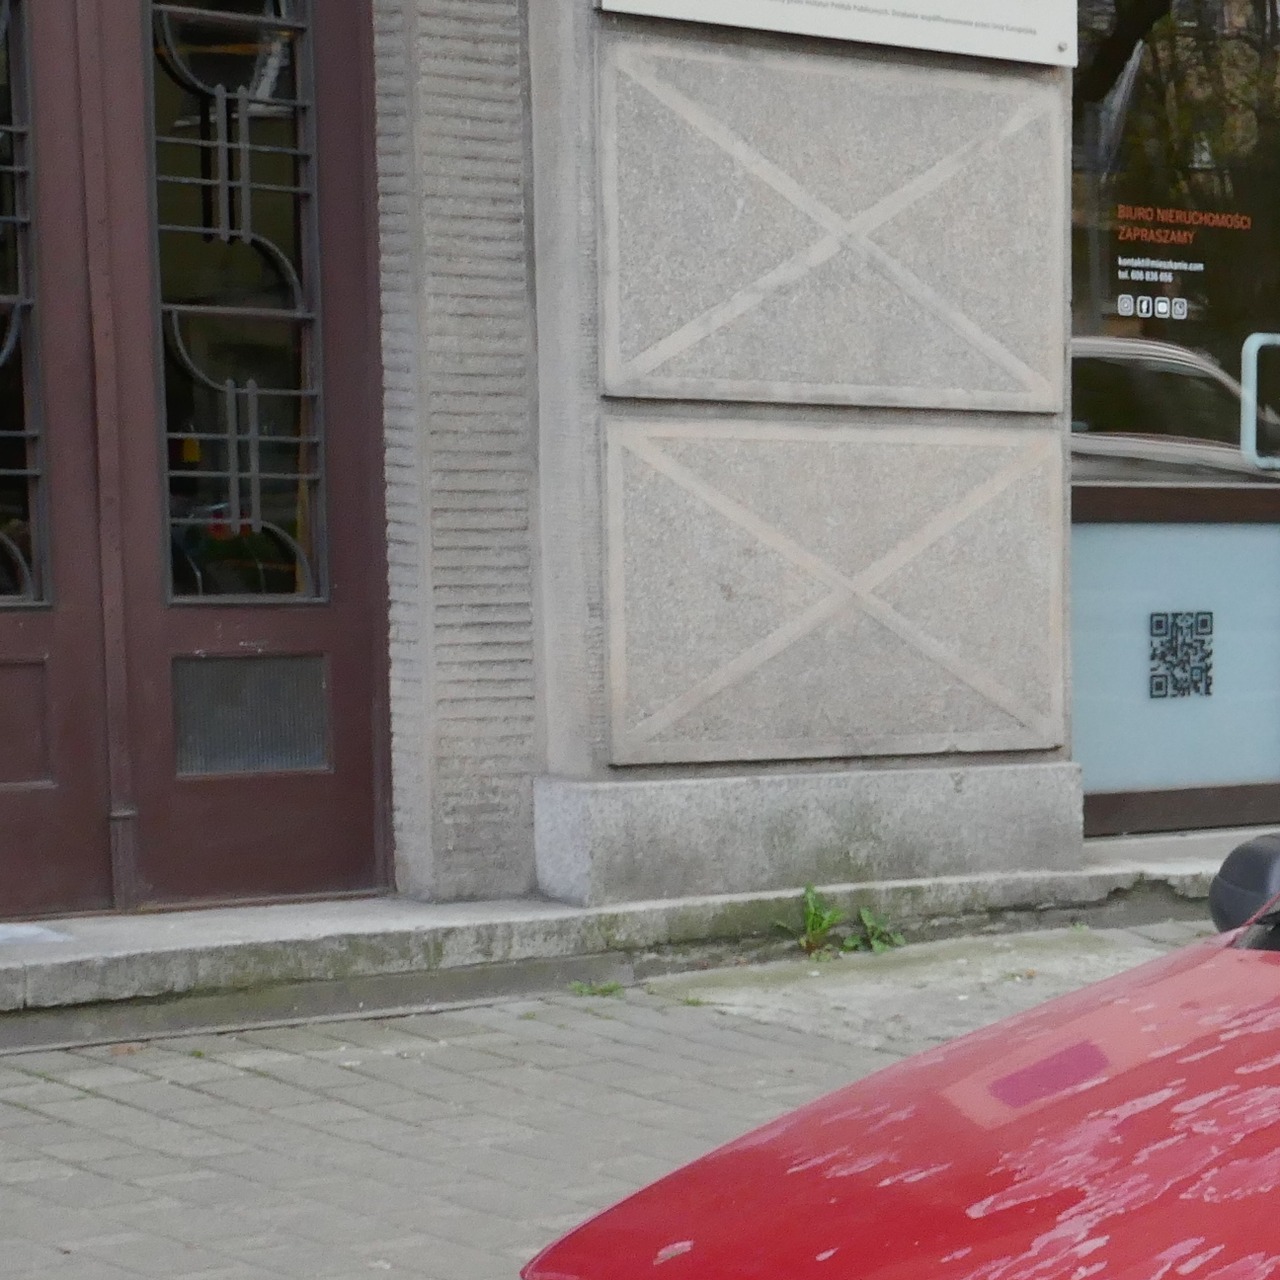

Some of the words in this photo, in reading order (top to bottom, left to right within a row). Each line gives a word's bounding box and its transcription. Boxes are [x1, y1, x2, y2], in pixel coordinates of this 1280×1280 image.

[1118, 204, 1154, 221] BIURO
[1157, 208, 1251, 229] NIERUCHOMOŚCI
[1118, 226, 1195, 244] ZAPRASZAMY
